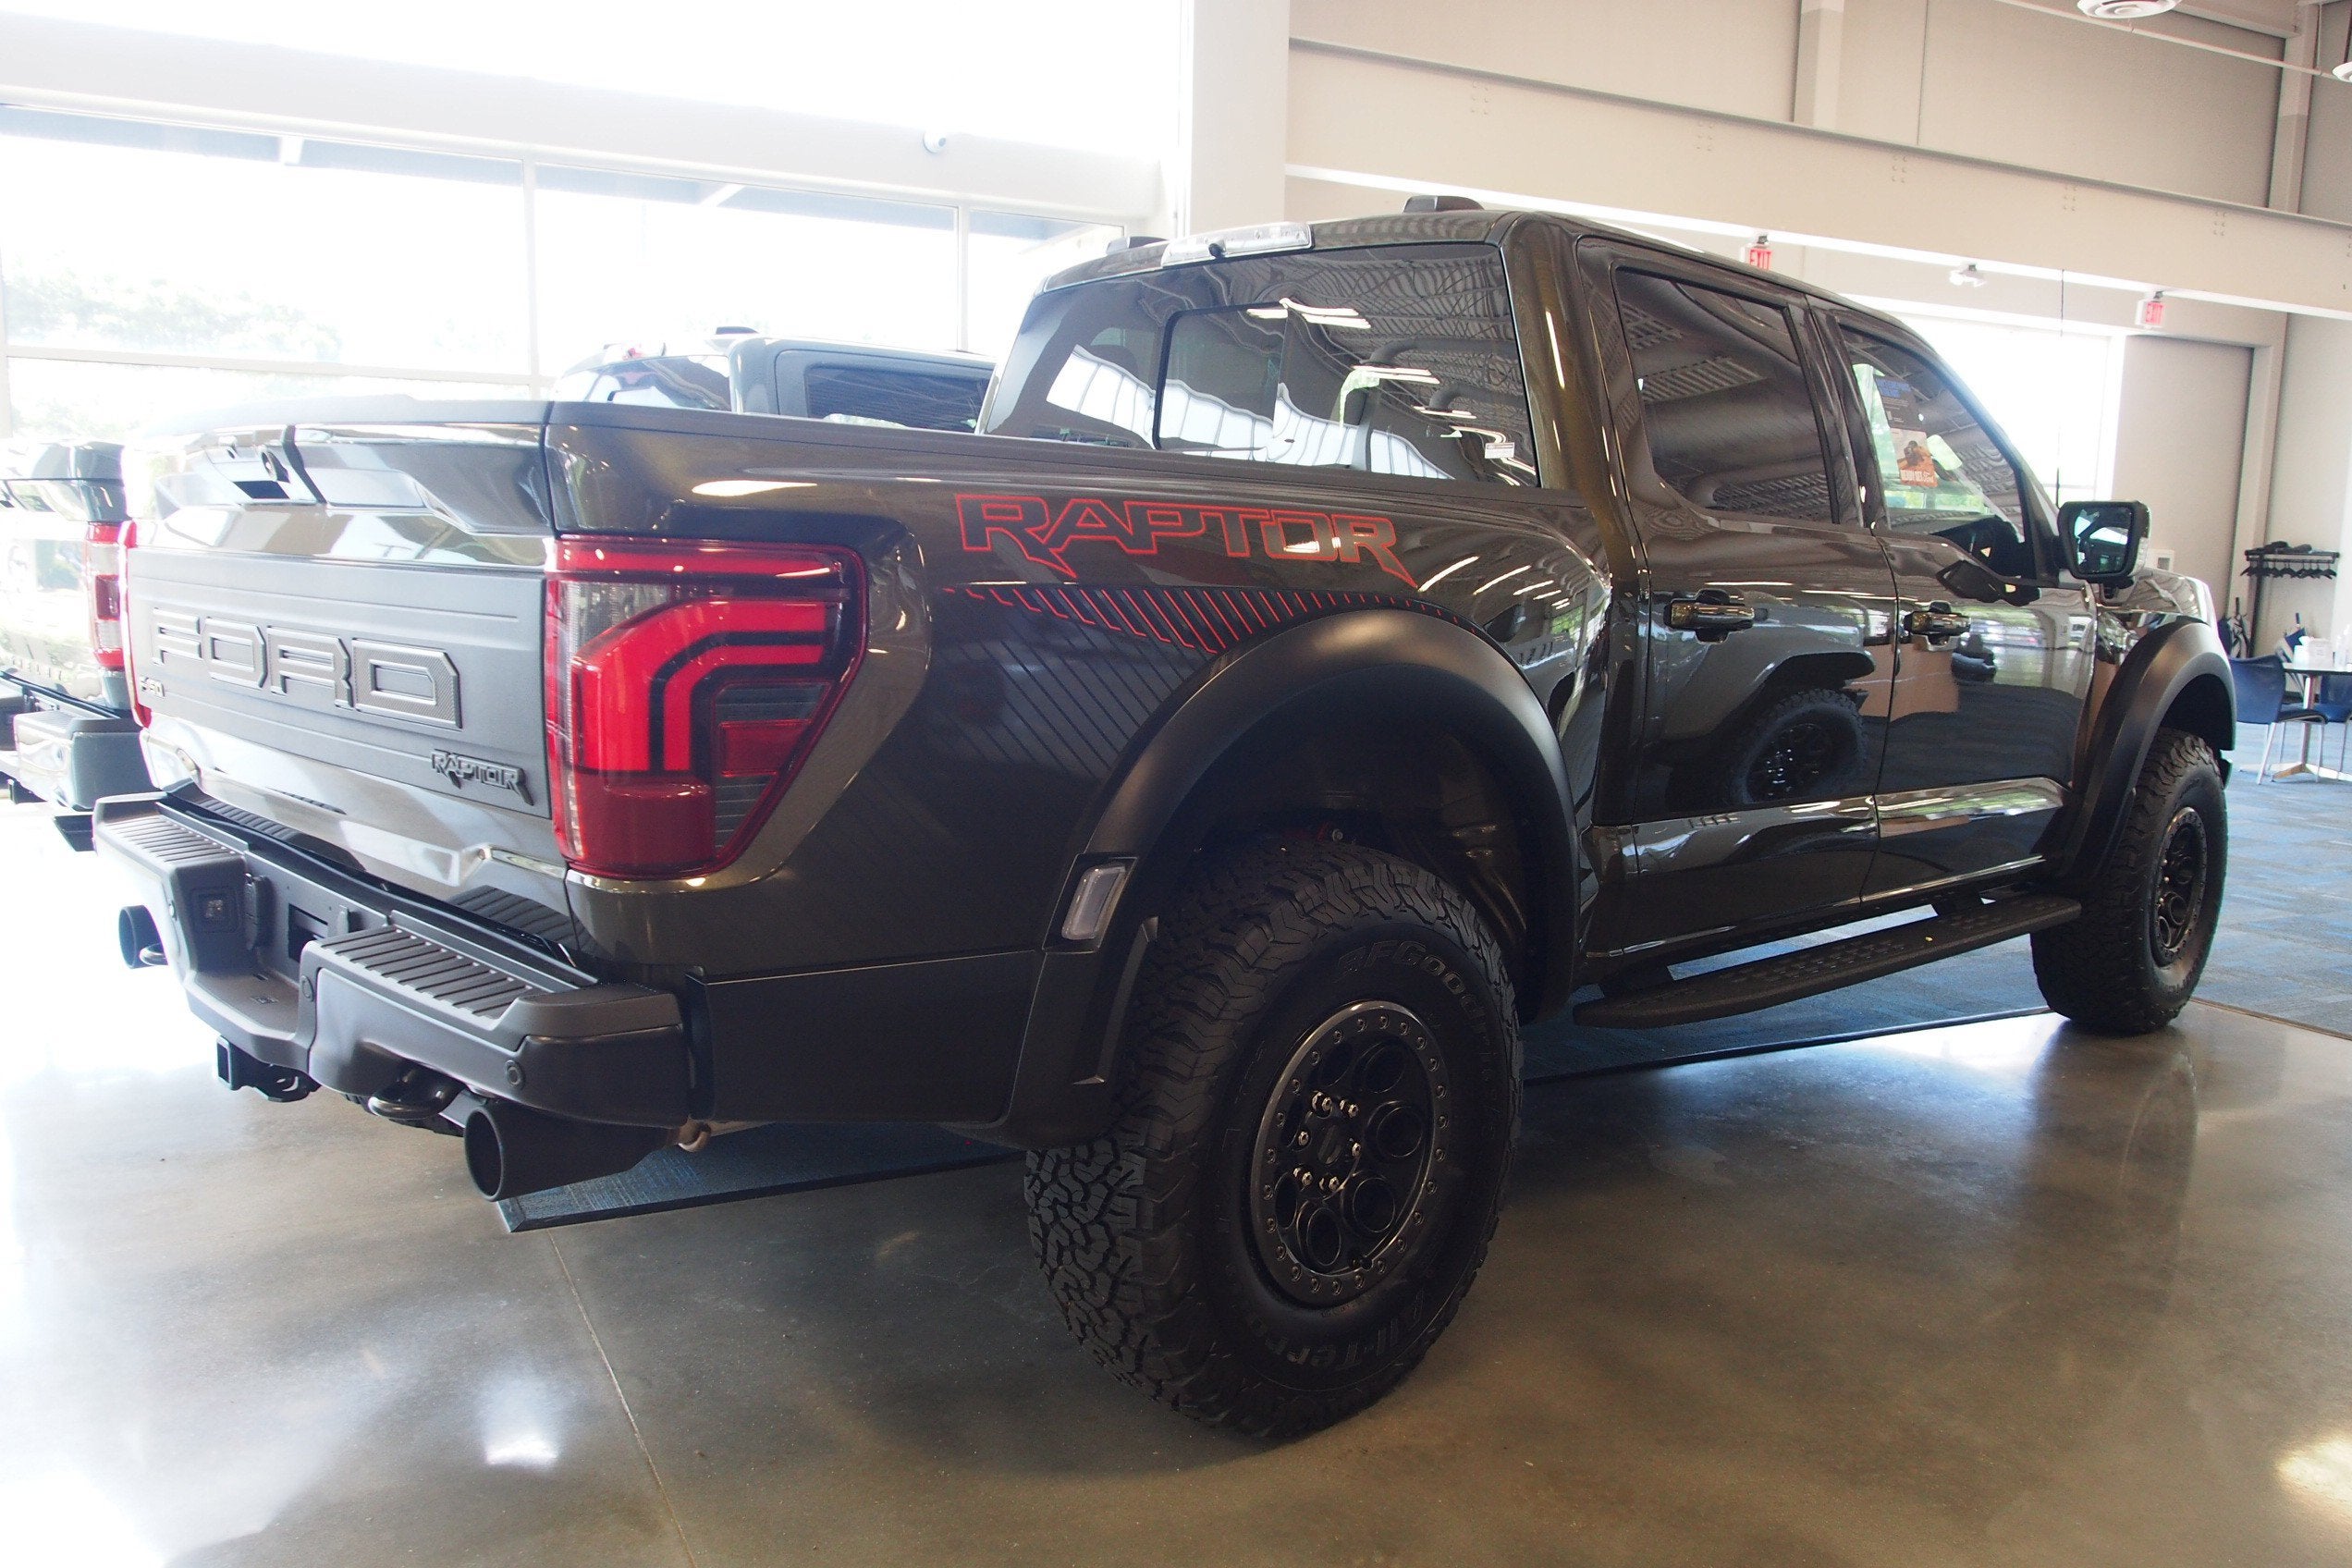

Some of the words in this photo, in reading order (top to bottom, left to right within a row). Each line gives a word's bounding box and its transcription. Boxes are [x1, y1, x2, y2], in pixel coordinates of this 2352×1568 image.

[1749, 249, 1771, 270] EXIT
[2145, 303, 2164, 325] EXIT
[955, 493, 1419, 592] RAPTOR
[152, 606, 462, 730] FORD
[430, 747, 534, 806] RAPTOR
